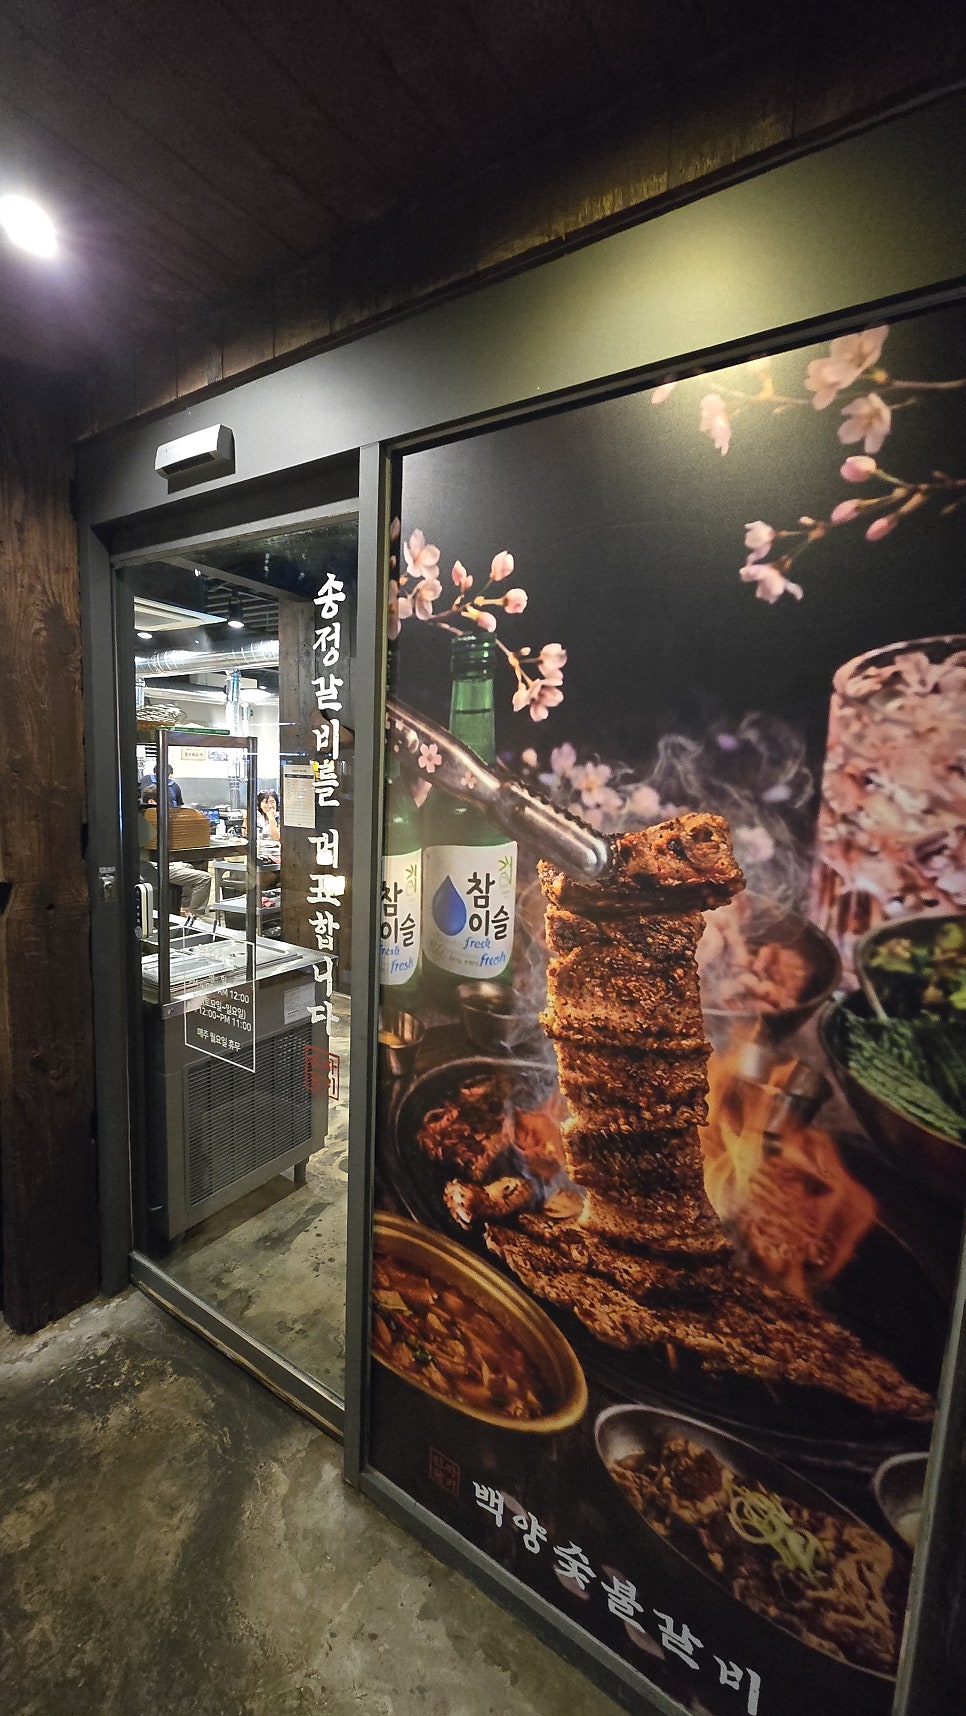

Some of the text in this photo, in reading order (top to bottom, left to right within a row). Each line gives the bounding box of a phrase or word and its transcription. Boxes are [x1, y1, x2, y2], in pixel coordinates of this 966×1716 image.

[311, 572, 346, 807] 송정갈비를
[381, 880, 416, 948] 참이슬
[465, 871, 510, 941] 참이슬
[306, 828, 345, 1035] 대표합니다
[390, 957, 414, 974] fresh
[480, 949, 506, 967] fresh
[229, 989, 250, 1004] 12:00
[231, 1017, 252, 1032] 11:00
[196, 1027, 241, 1052] 매주 월요일 휴무
